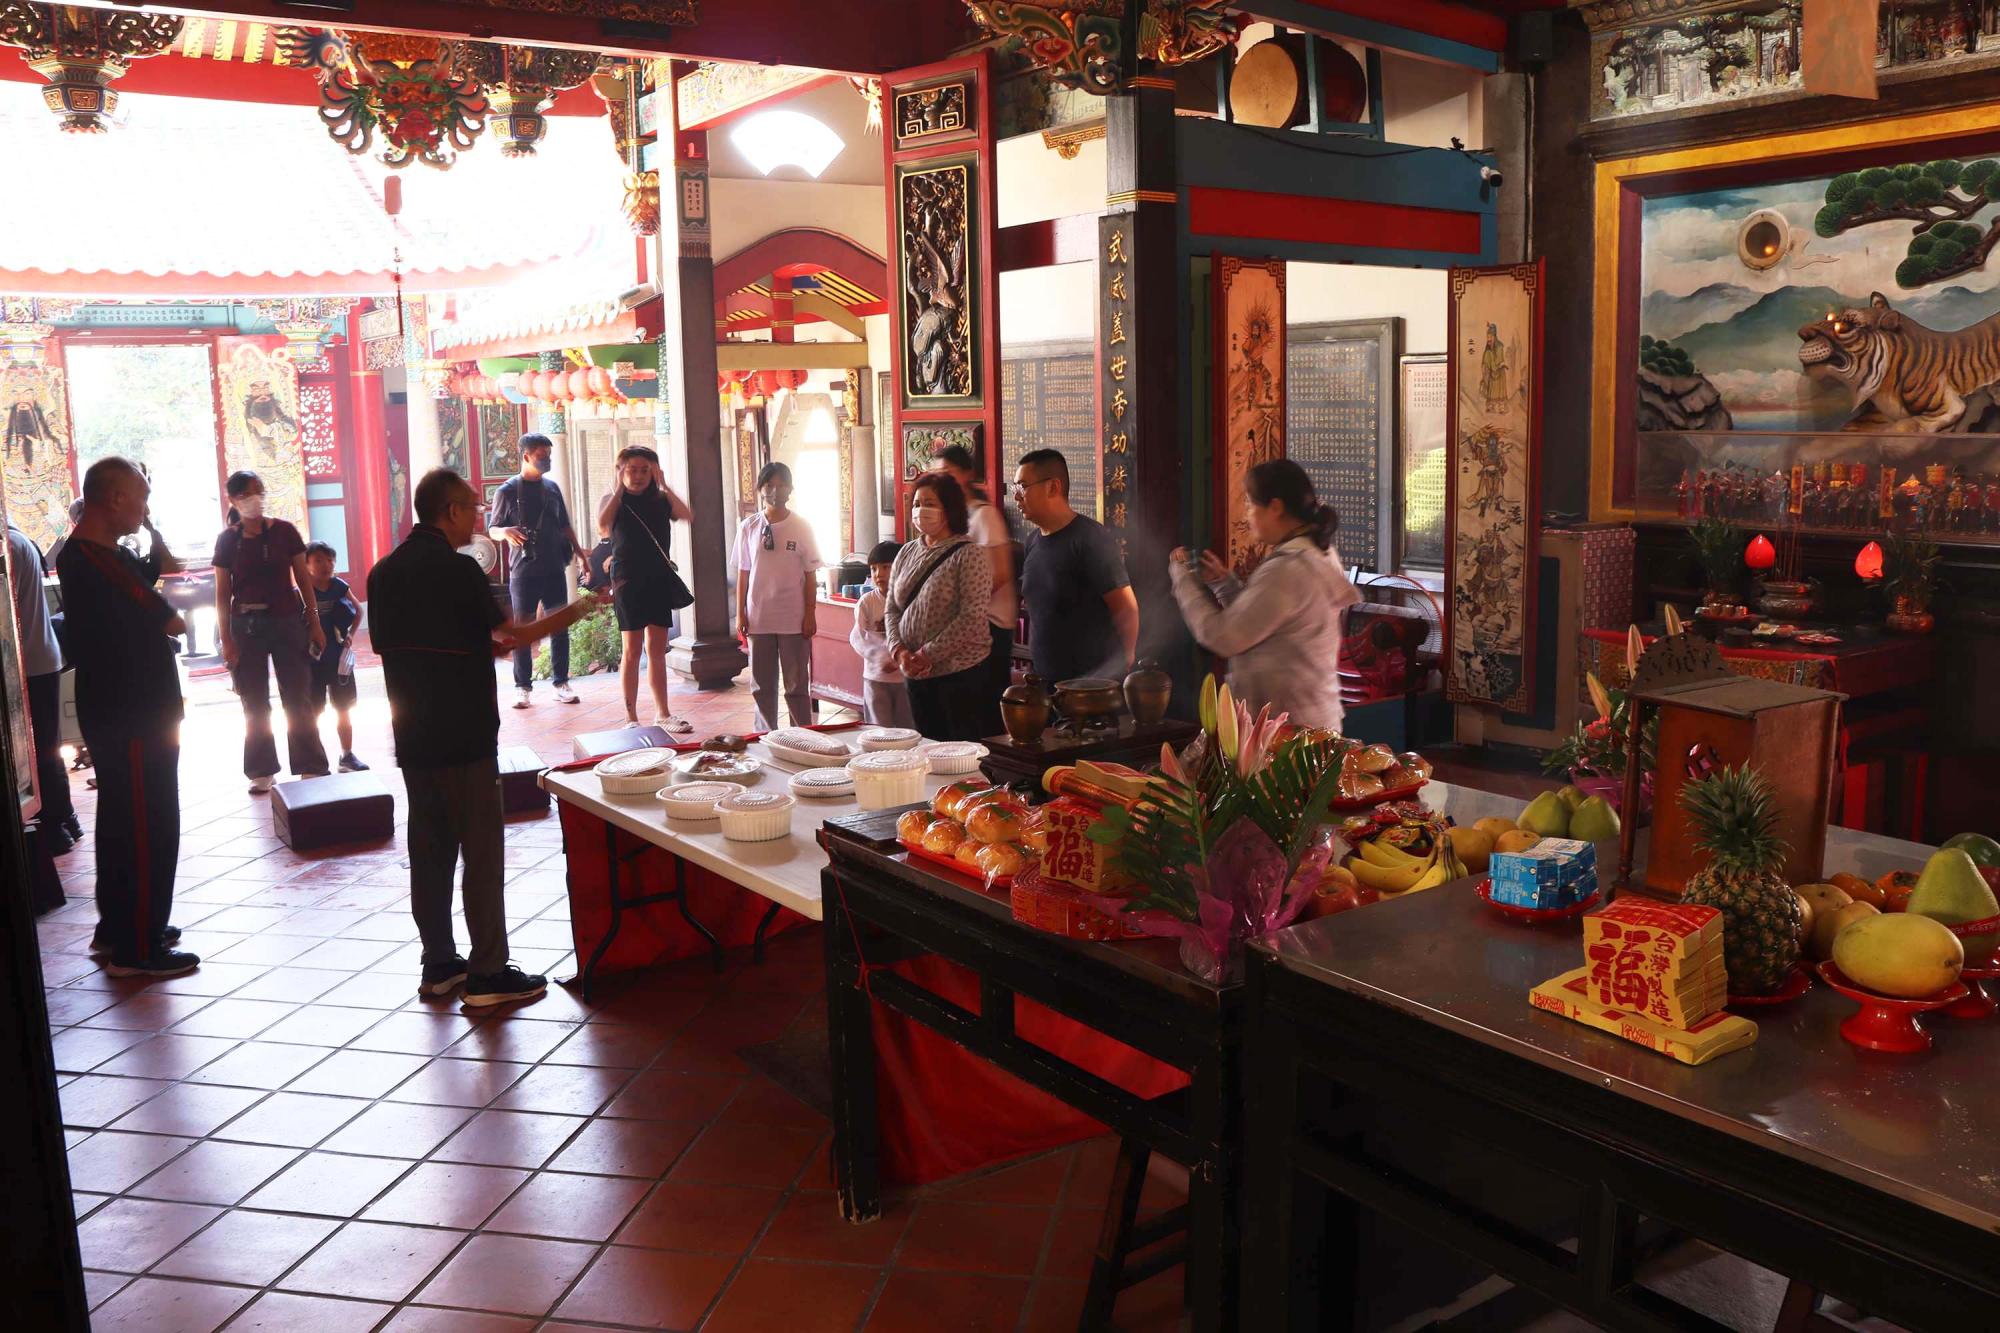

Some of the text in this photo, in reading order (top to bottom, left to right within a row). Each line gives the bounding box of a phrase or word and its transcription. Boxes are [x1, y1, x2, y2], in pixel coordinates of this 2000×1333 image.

[1044, 811, 1084, 879] 福
[1588, 921, 1650, 1012] 福
[1647, 931, 1677, 1022] 台灣製造
